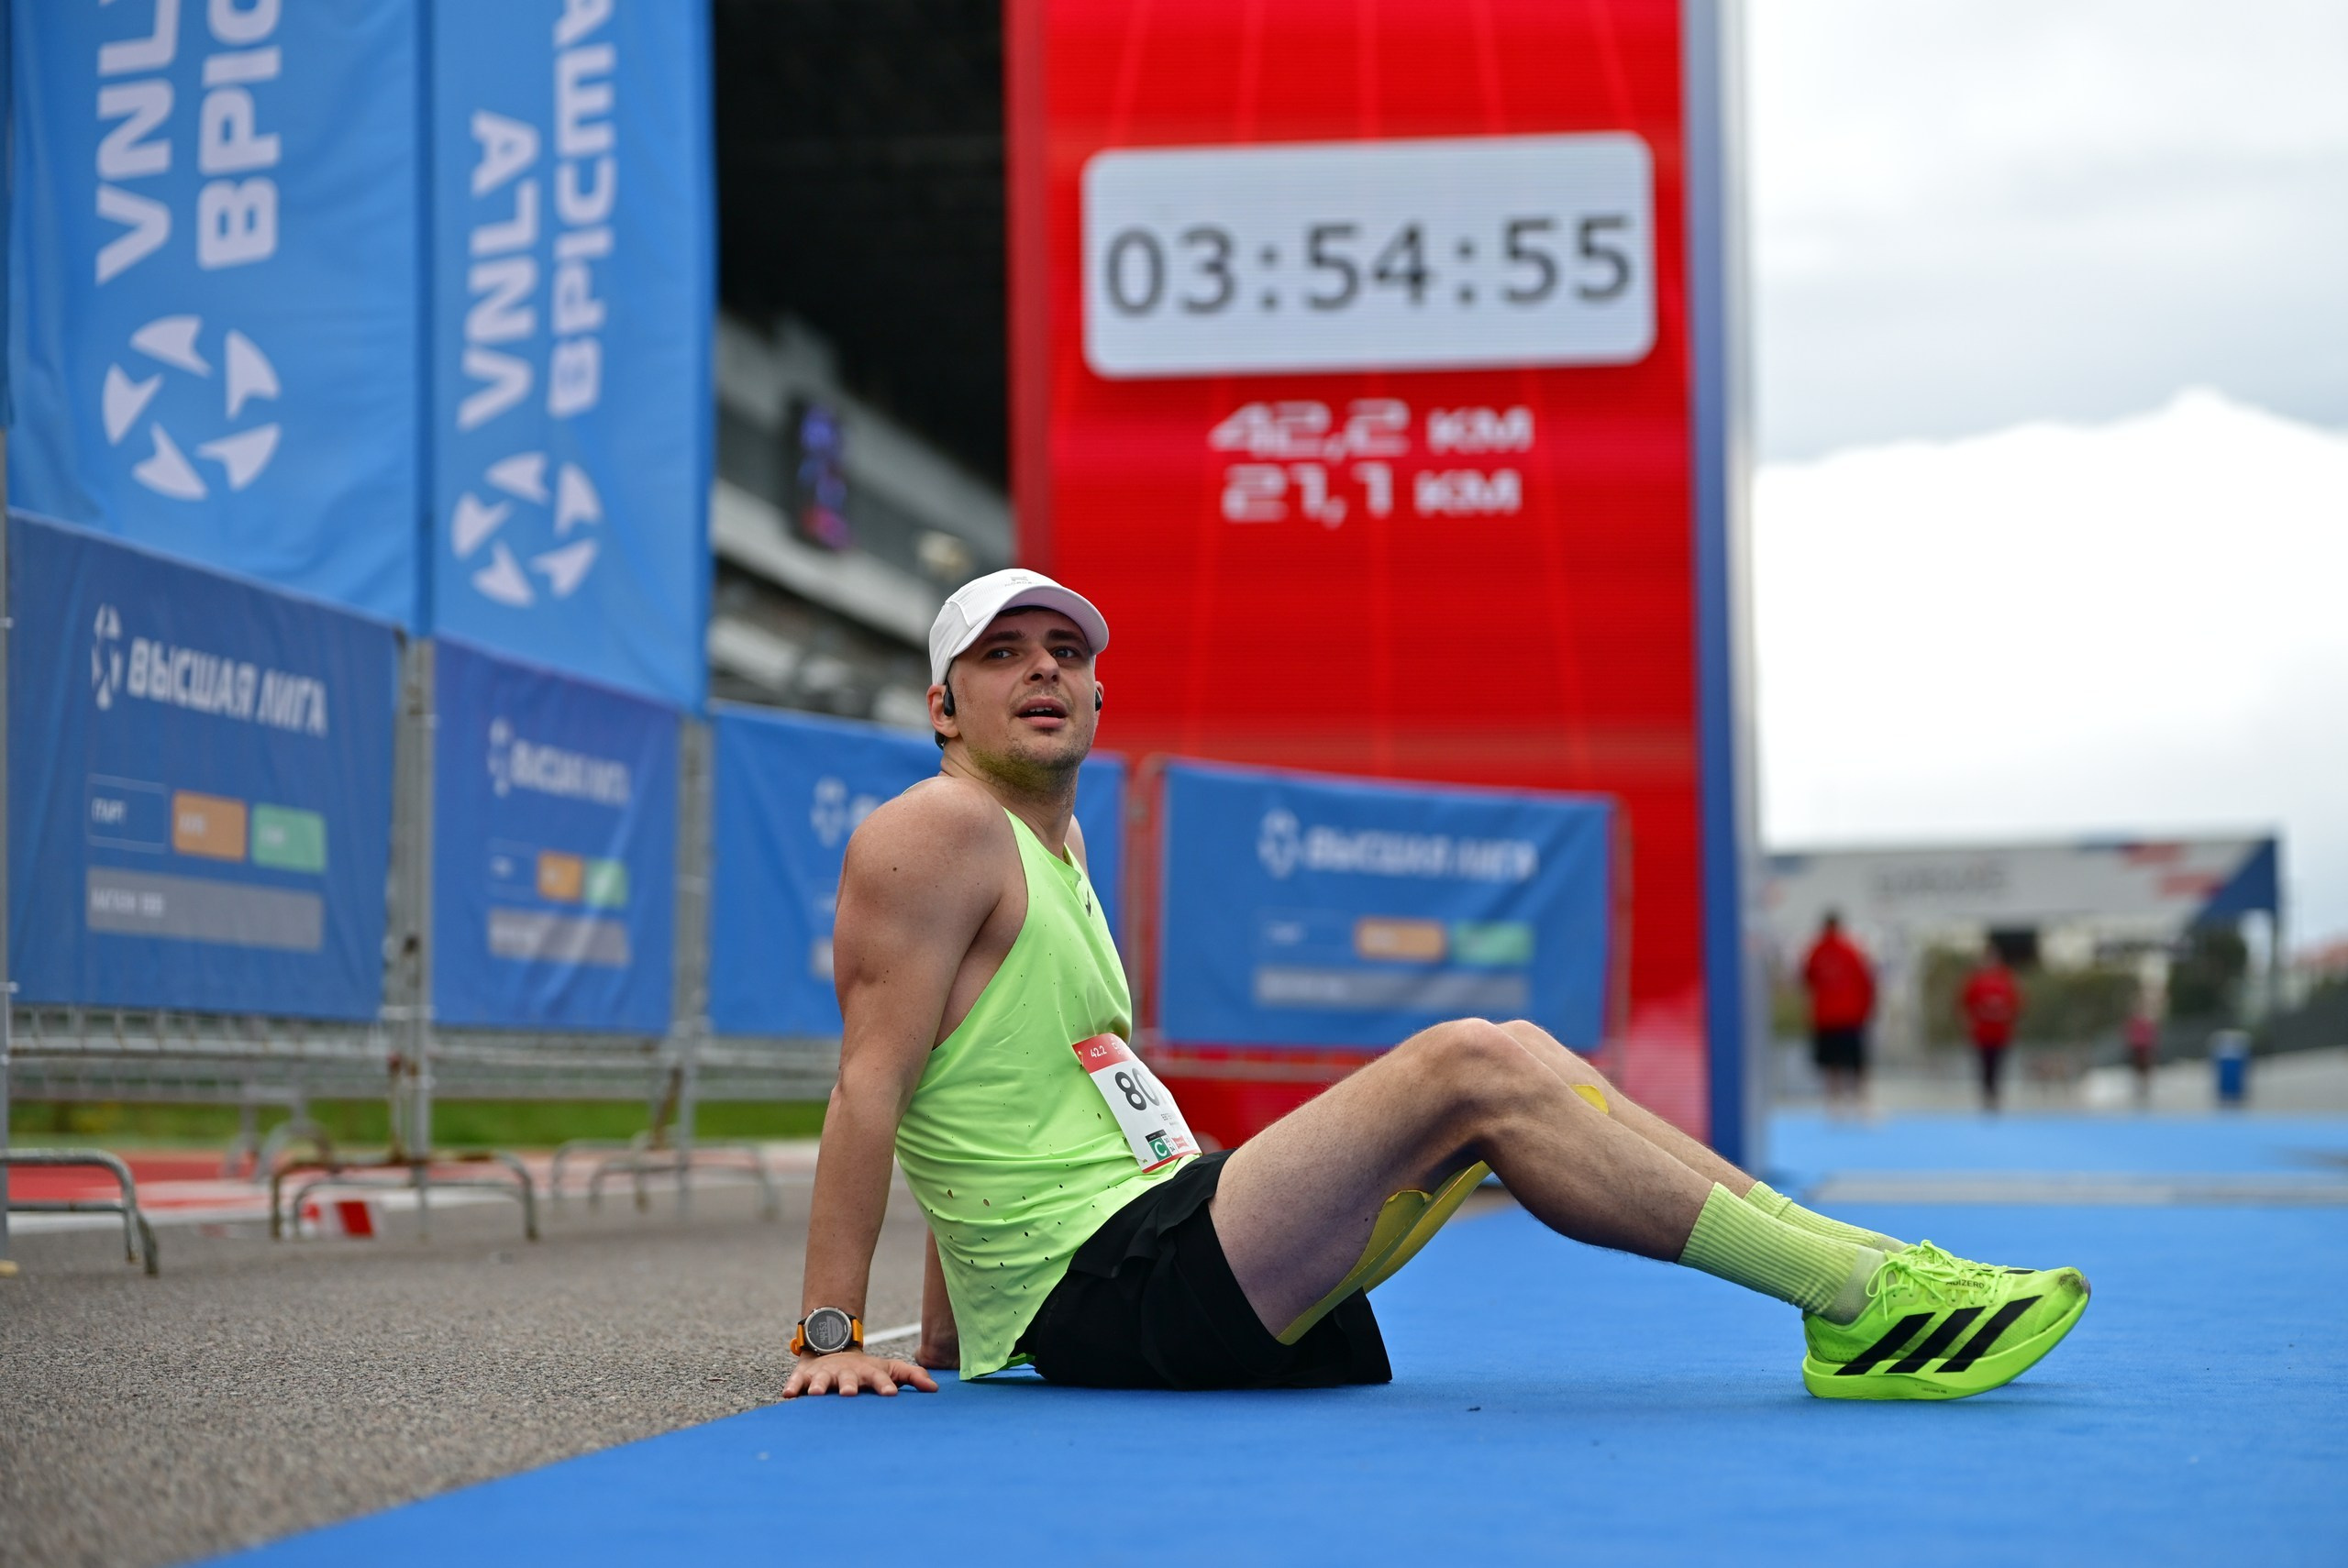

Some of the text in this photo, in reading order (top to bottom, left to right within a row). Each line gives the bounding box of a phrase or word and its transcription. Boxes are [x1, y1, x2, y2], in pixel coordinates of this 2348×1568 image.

[1104, 217, 1634, 317] 03:54:55
[1210, 400, 1410, 463] 42,2
[1222, 462, 1391, 527] 21,1
[127, 637, 327, 739] ВЫСШАЯ ЛИГА
[1114, 1066, 1166, 1110] 80
